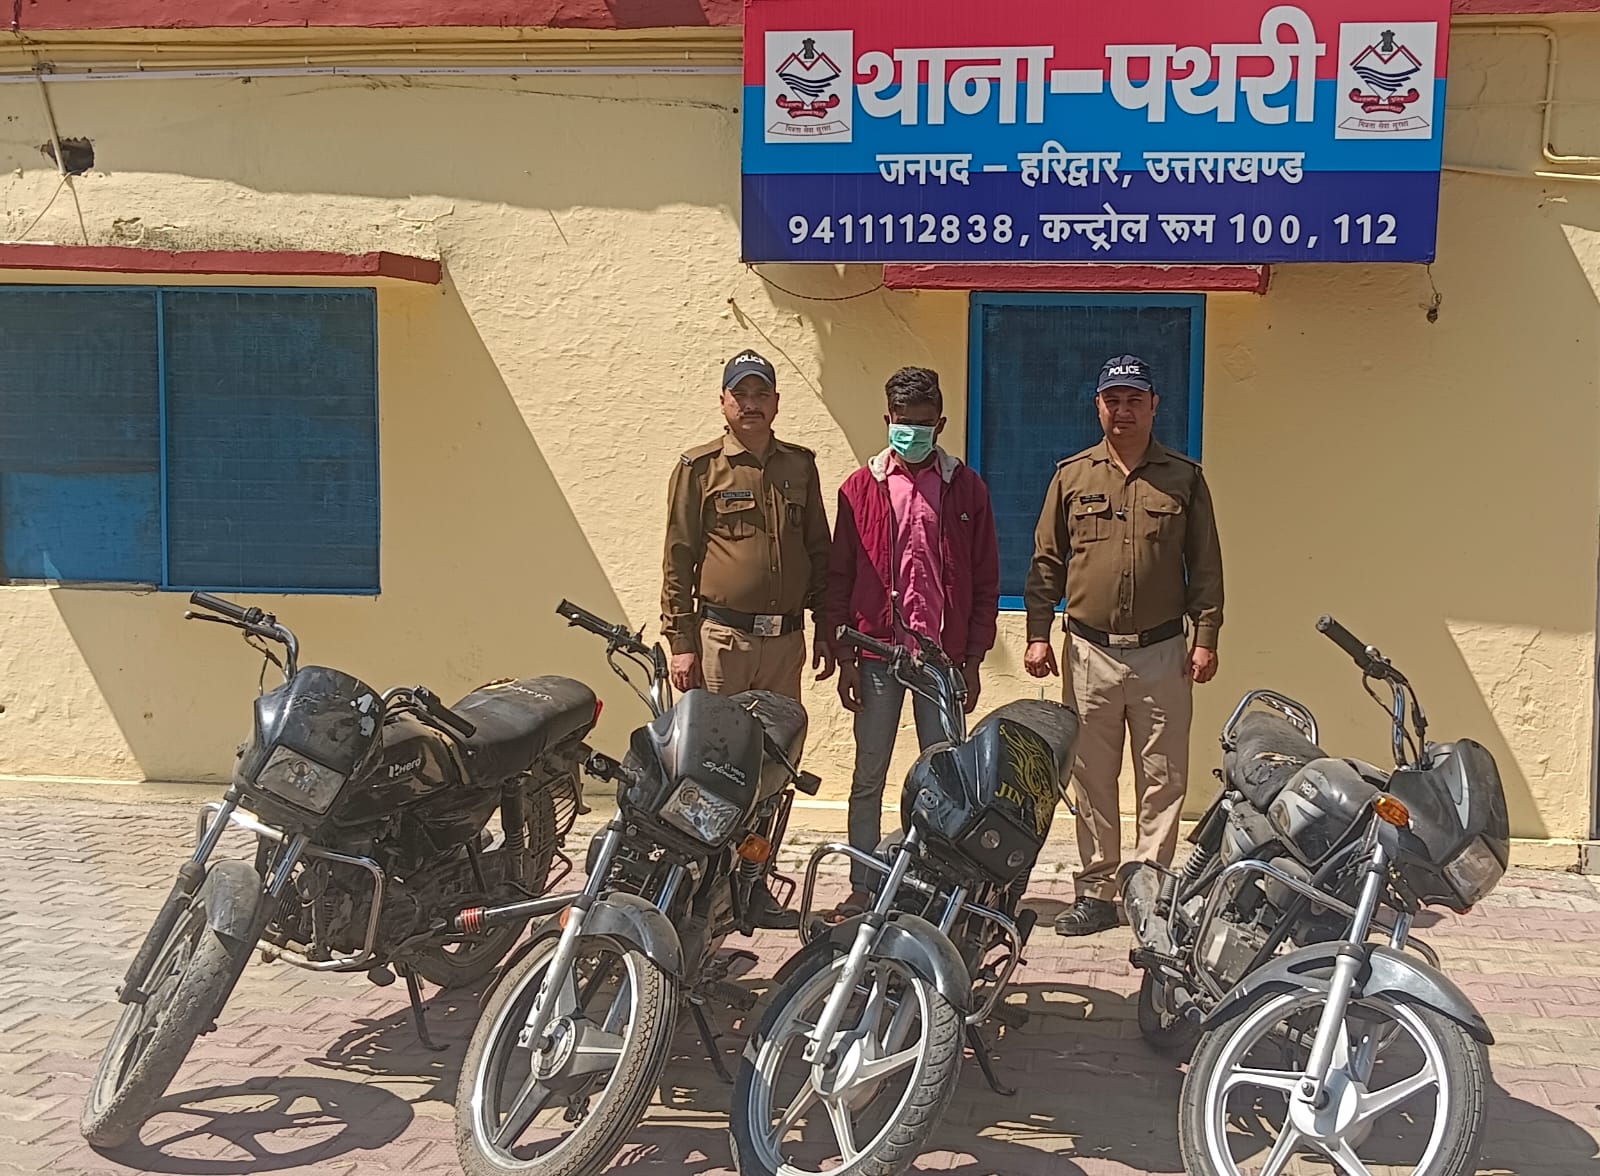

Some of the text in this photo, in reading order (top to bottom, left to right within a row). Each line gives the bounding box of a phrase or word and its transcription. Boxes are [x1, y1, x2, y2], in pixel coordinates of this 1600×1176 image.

[876, 154, 972, 185] जनपद
[1018, 141, 1132, 188] हरिद्वार,
[1144, 153, 1305, 184] उत्तराखण्ड
[1039, 203, 1150, 251] कन्ट्रोल
[1157, 214, 1217, 244] रूम
[1333, 213, 1397, 244] 112
[735, 354, 766, 366] POLICE
[1108, 365, 1141, 377] POLICE
[398, 757, 421, 775] Hero
